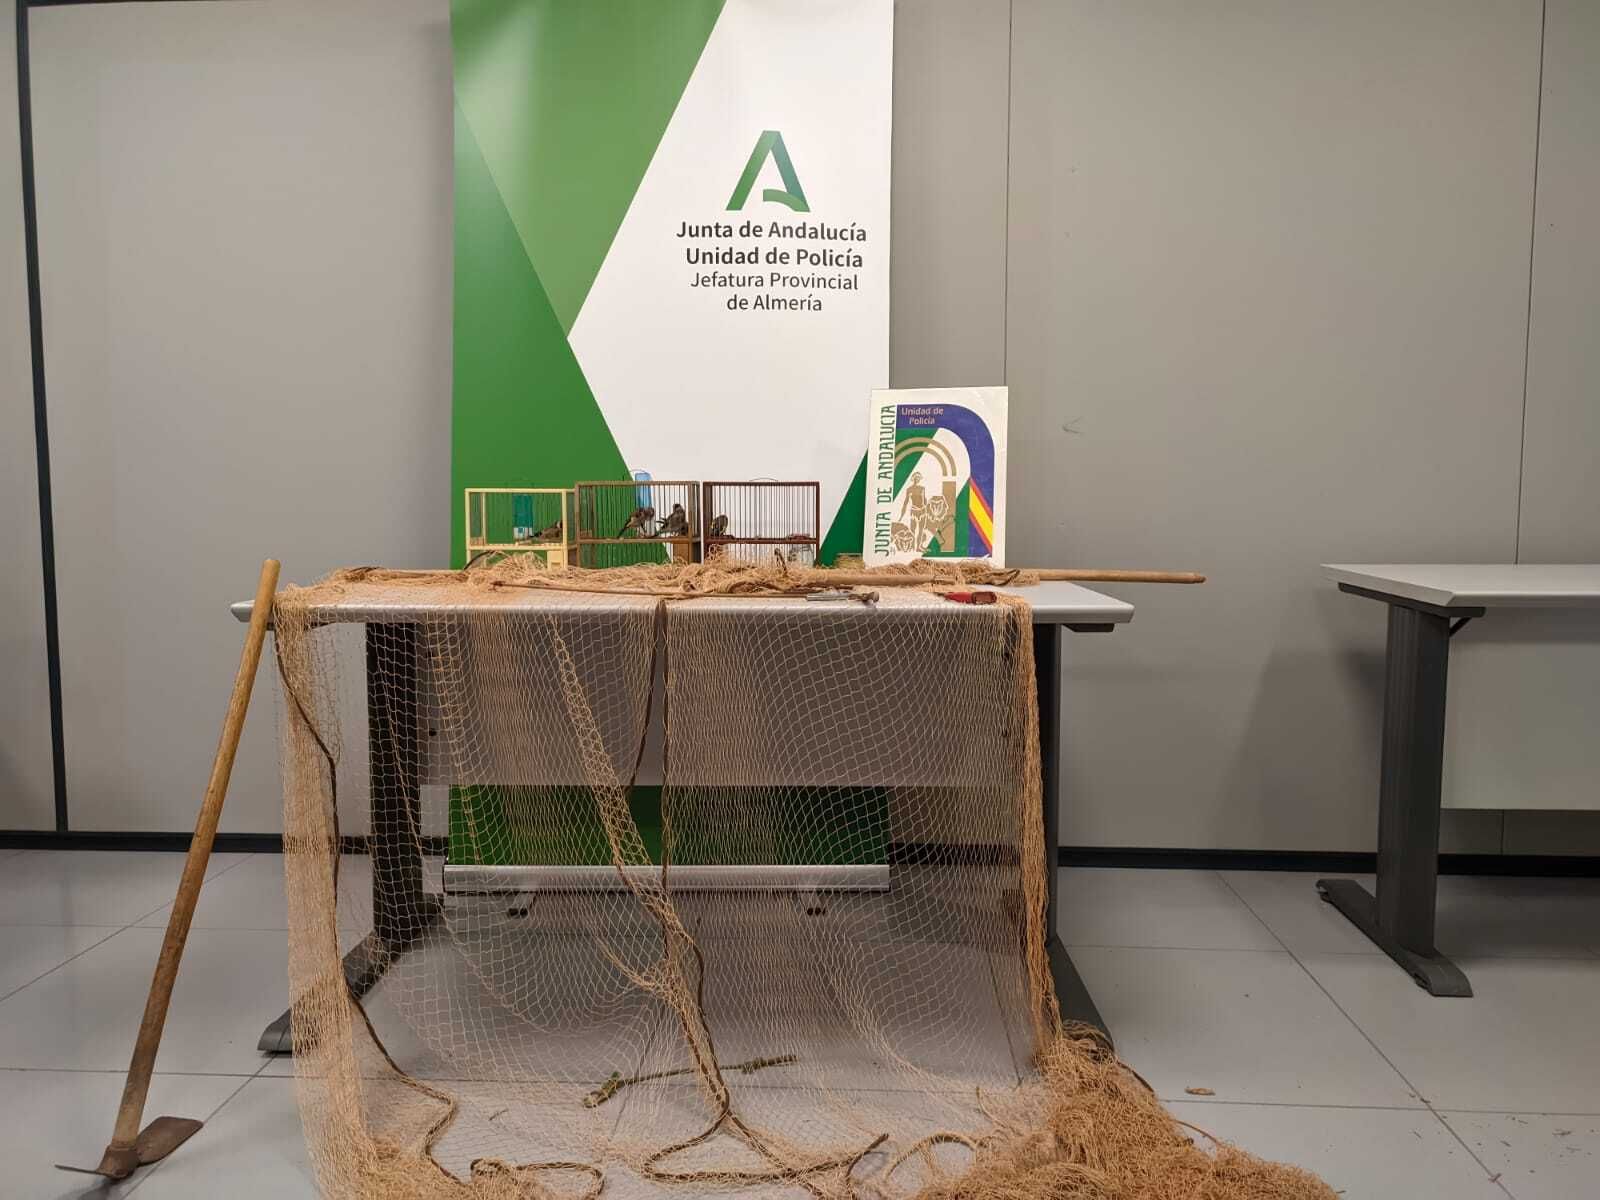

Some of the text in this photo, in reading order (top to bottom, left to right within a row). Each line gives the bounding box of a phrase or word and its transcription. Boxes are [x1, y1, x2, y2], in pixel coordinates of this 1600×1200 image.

[676, 220, 867, 241] Junta de Andalucía
[686, 246, 863, 267] Unidad de Policía
[690, 271, 858, 290] Jefatura Provincial
[726, 294, 823, 311] de Almería
[901, 407, 944, 416] Unidad de
[877, 487, 892, 504] DE
[875, 511, 891, 557] JUNTA
